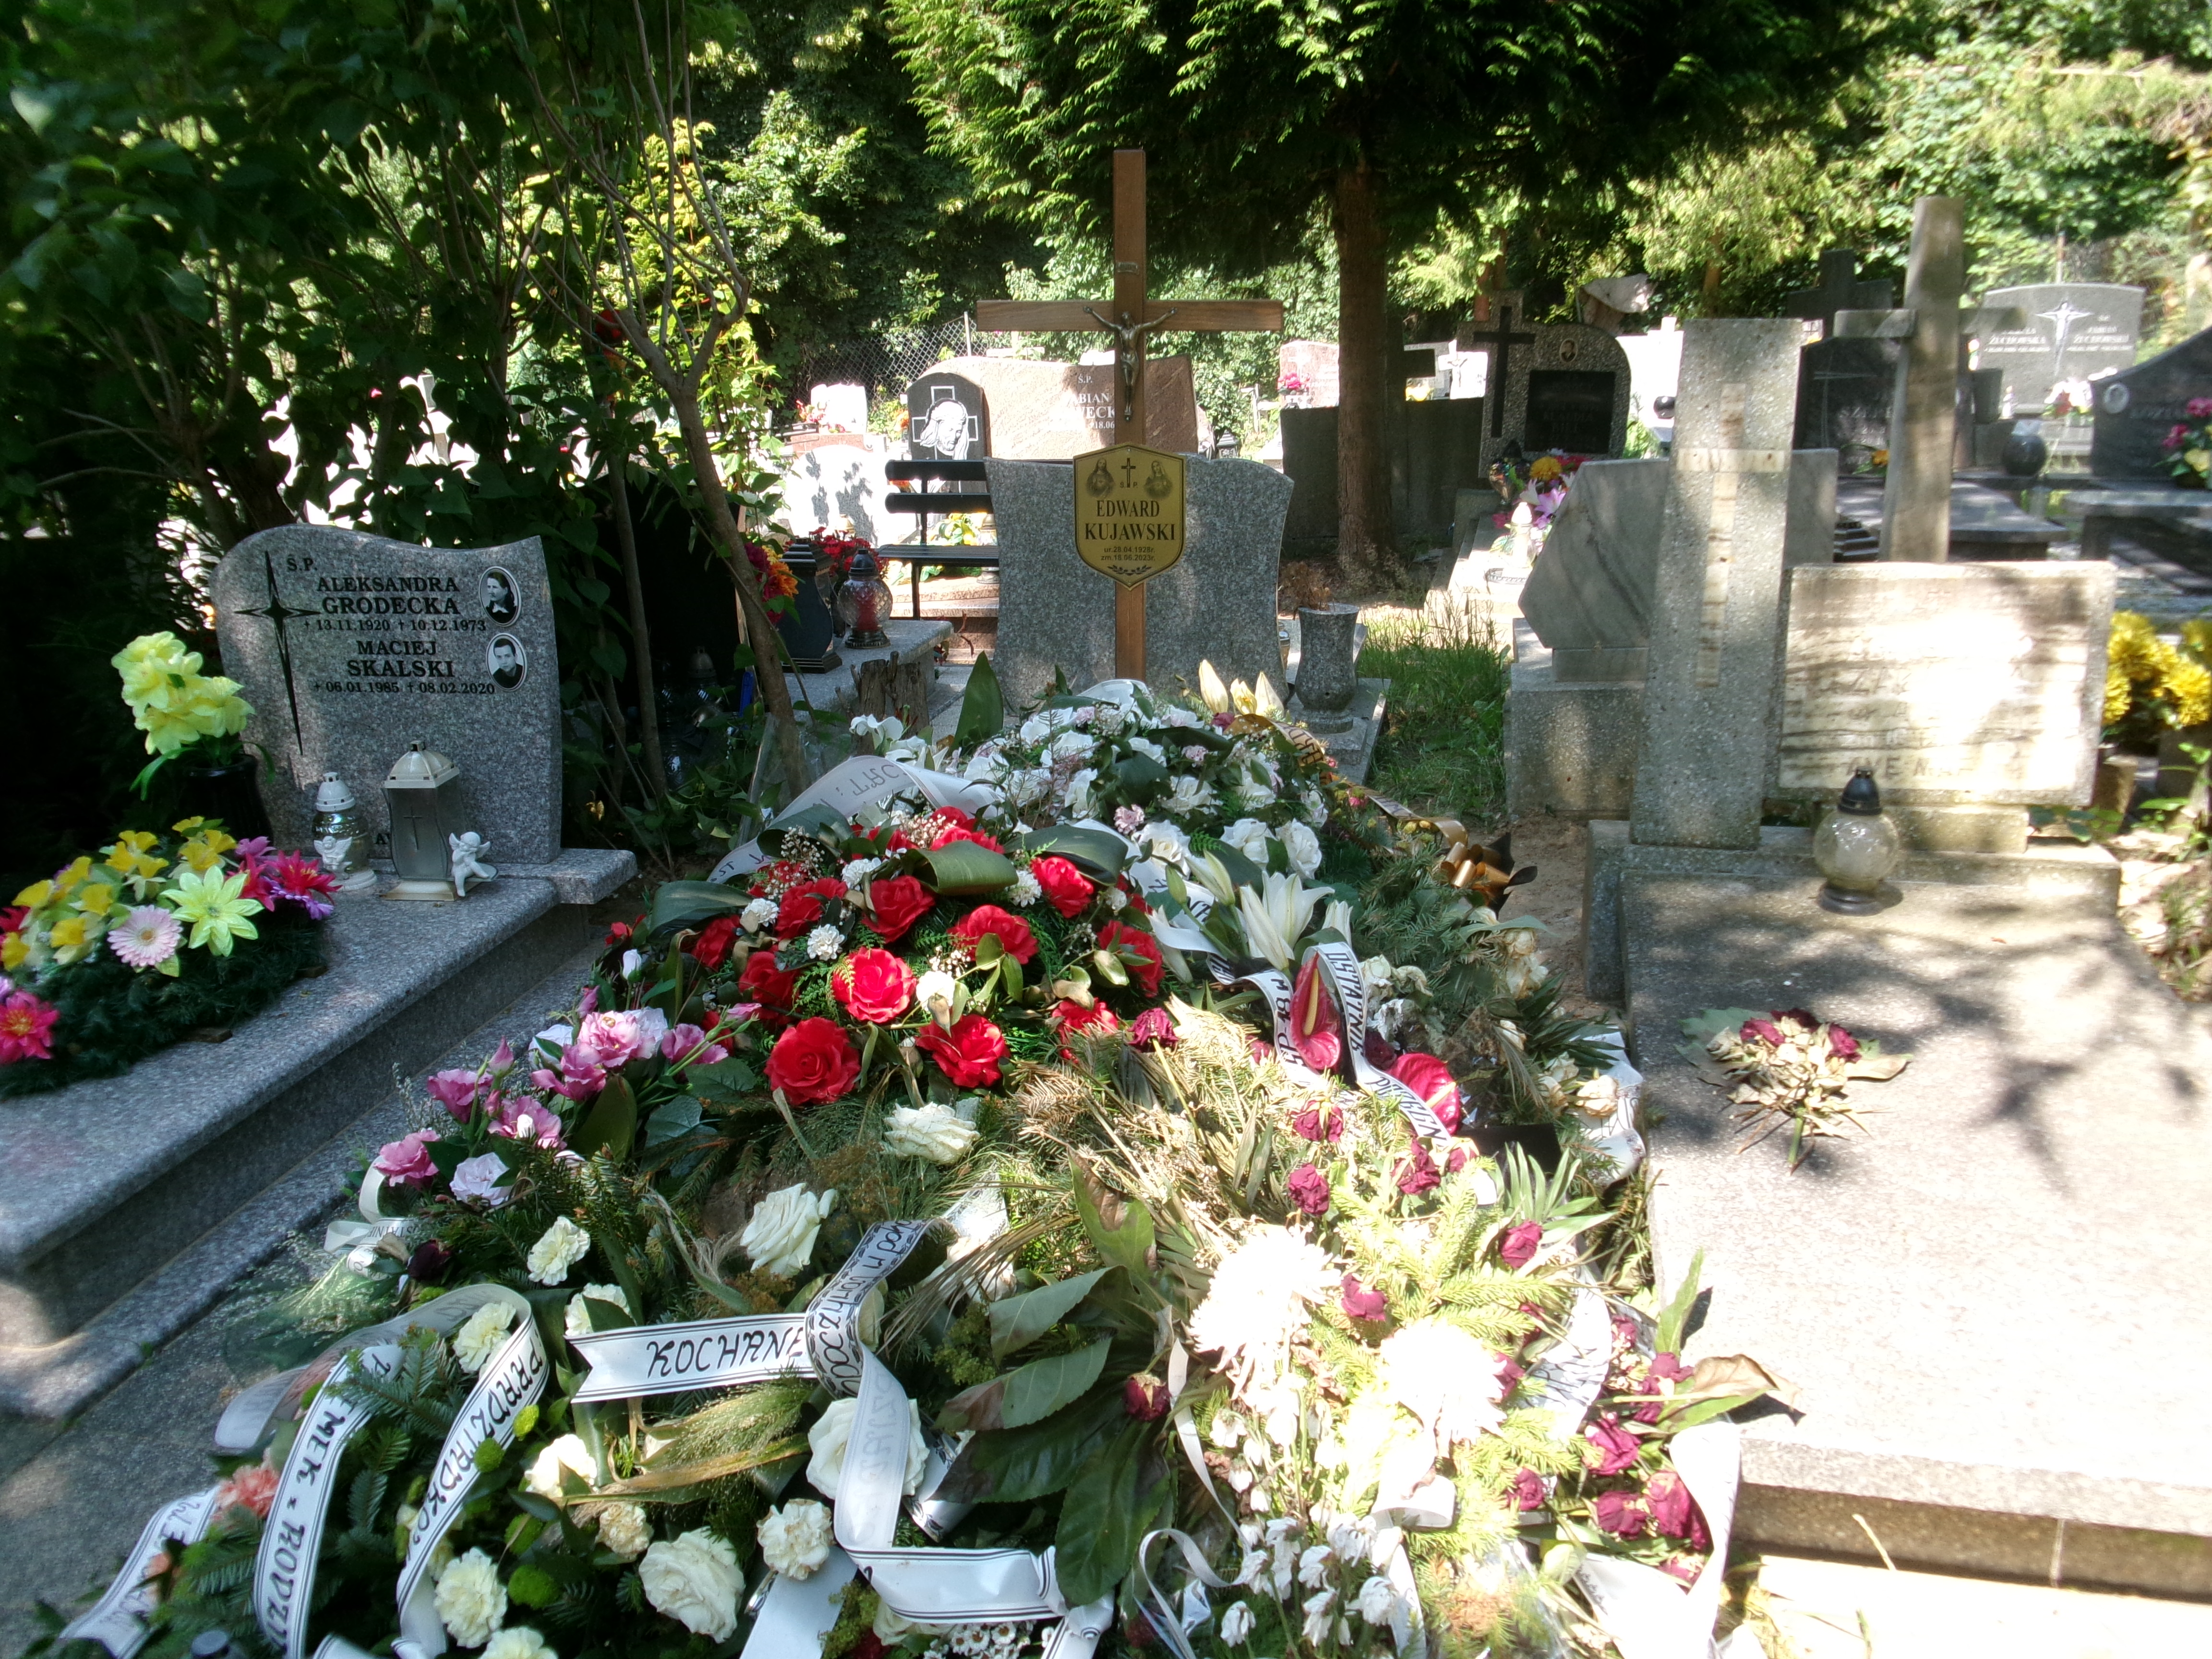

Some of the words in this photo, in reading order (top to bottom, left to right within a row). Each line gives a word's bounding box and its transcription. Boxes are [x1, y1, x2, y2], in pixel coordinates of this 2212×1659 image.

[1096, 500, 1160, 517] EDWARD
[1085, 523, 1176, 541] KUJAWSKI
[317, 577, 460, 592] ALEKSANDRA
[322, 597, 461, 614] GRODECKA
[356, 640, 436, 655] MACIEJ
[346, 660, 455, 678] SKALSKI
[325, 681, 399, 693] 06.01.1985
[419, 682, 495, 694] 08.02.2020
[1326, 952, 1365, 1056] OSTATNIE
[647, 1326, 805, 1378] KOCHANE
[414, 1337, 543, 1545] PRADZIADKO
